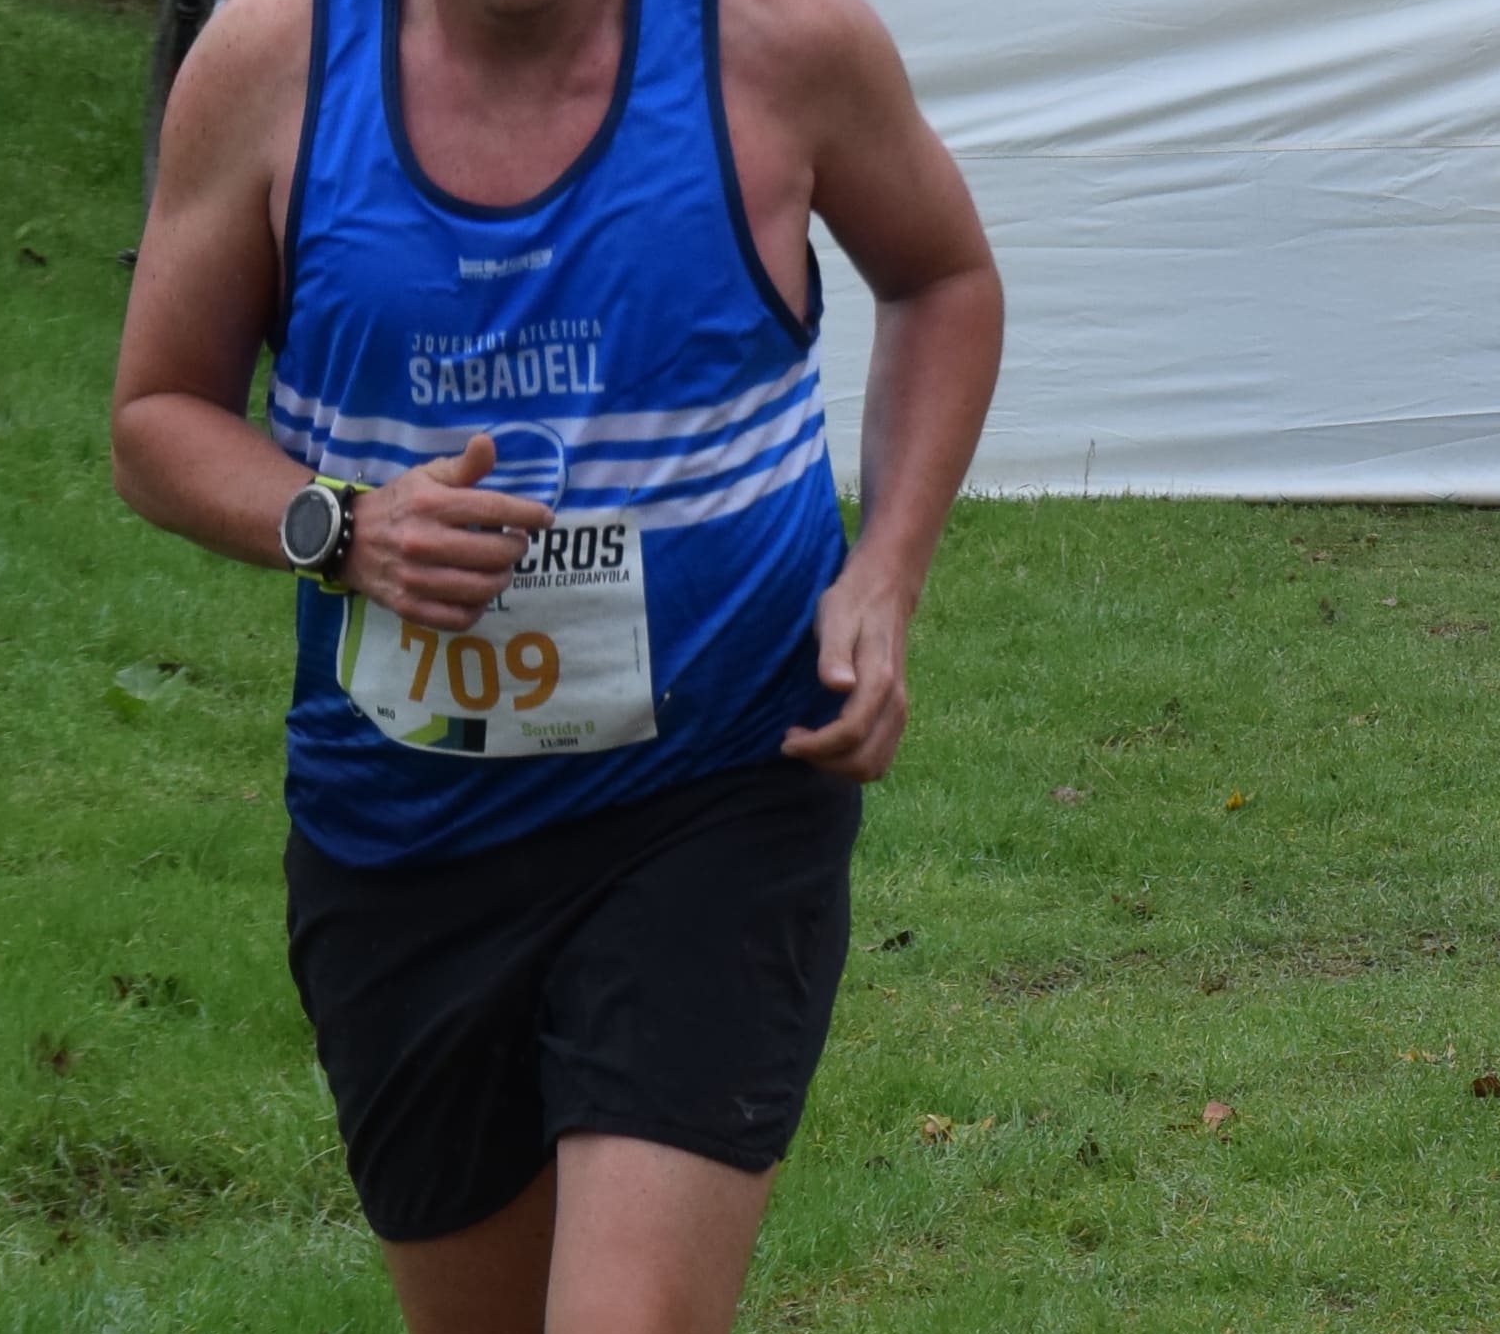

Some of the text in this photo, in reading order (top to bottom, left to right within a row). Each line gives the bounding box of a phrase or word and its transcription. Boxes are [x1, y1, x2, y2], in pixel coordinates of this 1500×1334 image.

[411, 329, 507, 354] JOVENTUT
[408, 343, 606, 406] SABADELL
[513, 569, 631, 590] CIUTAT CERDANYOLA
[401, 619, 561, 711] 709
